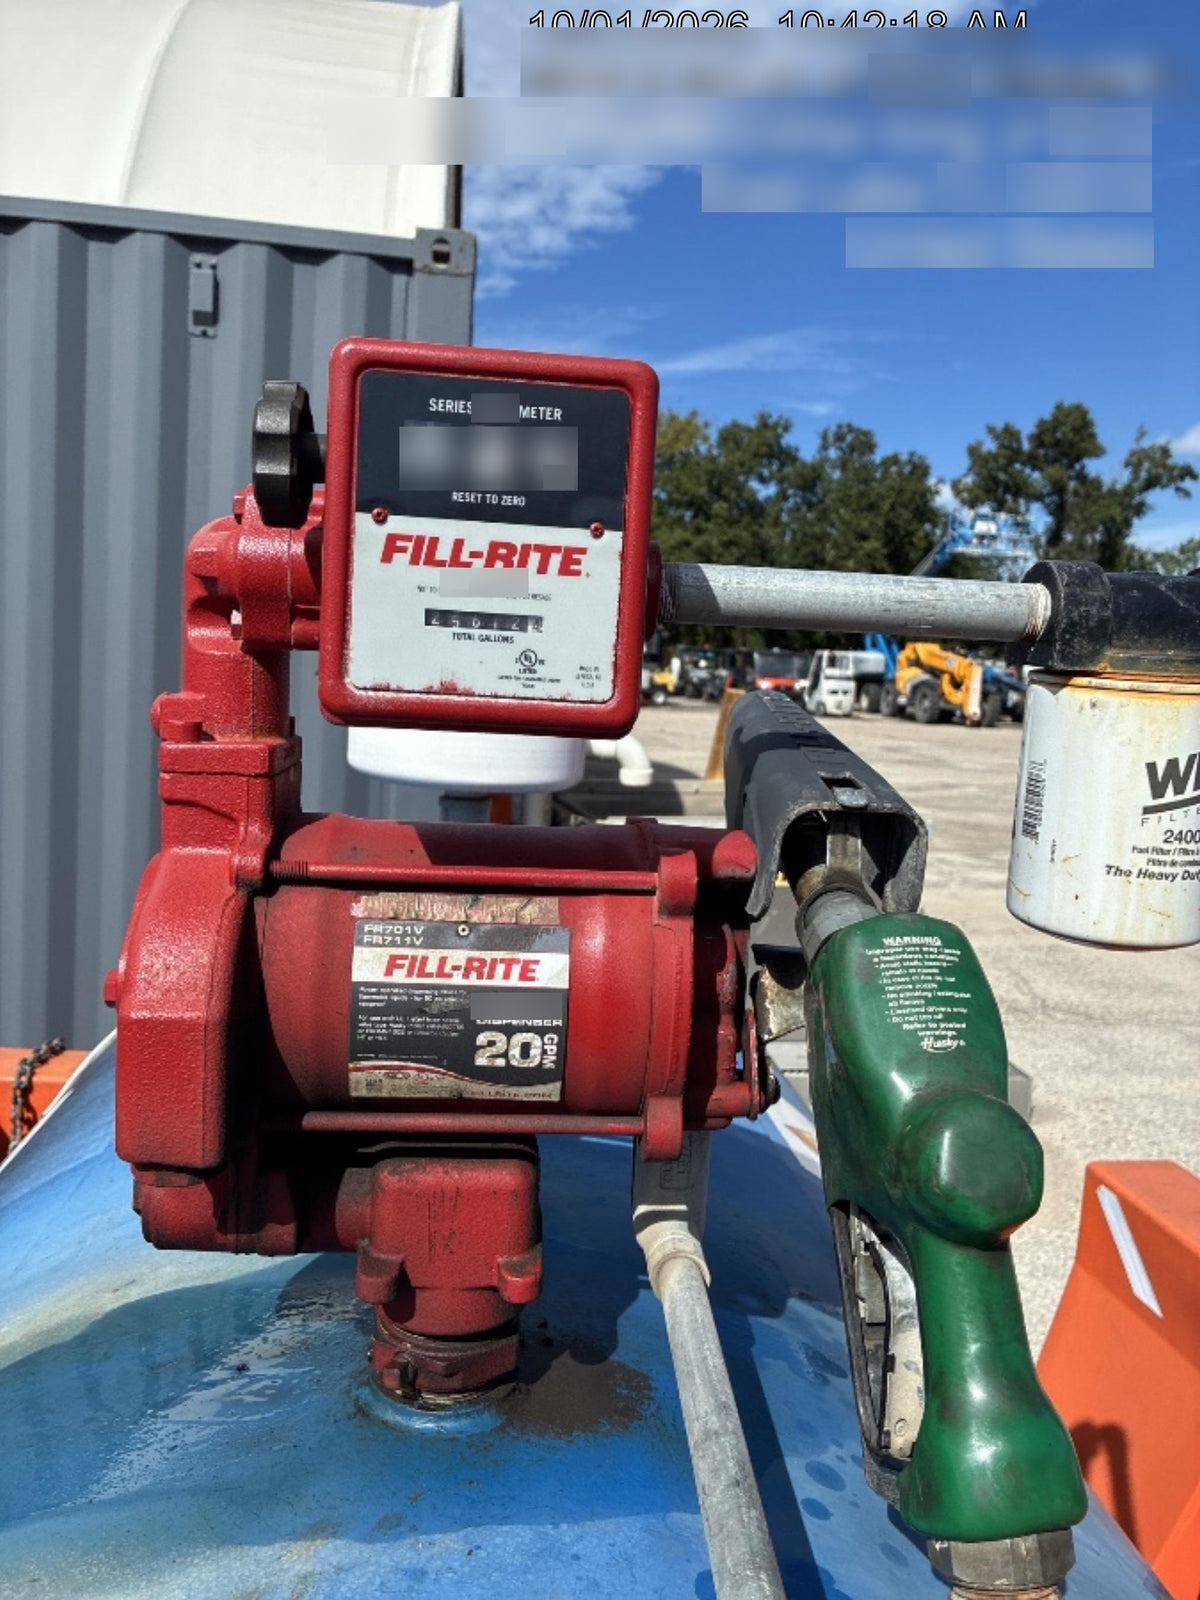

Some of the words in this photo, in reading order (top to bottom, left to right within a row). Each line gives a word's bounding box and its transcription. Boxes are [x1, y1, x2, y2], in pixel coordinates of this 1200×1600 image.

[429, 398, 472, 415] SERIES
[519, 405, 563, 421] METER
[452, 491, 482, 503] RESET
[486, 494, 498, 504] TO
[501, 495, 526, 506] ZERO
[380, 533, 588, 577] FILL-RITE
[478, 634, 515, 645] GALLONS
[1105, 864, 1133, 878] The
[1136, 868, 1179, 883] Heavy
[363, 924, 425, 935] FR701V
[363, 936, 424, 946] FR711V
[882, 936, 943, 947] WARNING
[384, 954, 541, 982] FILL-RITE
[474, 1031, 543, 1068] 20
[541, 1032, 560, 1070] GPM
[922, 1036, 961, 1053] Husky
